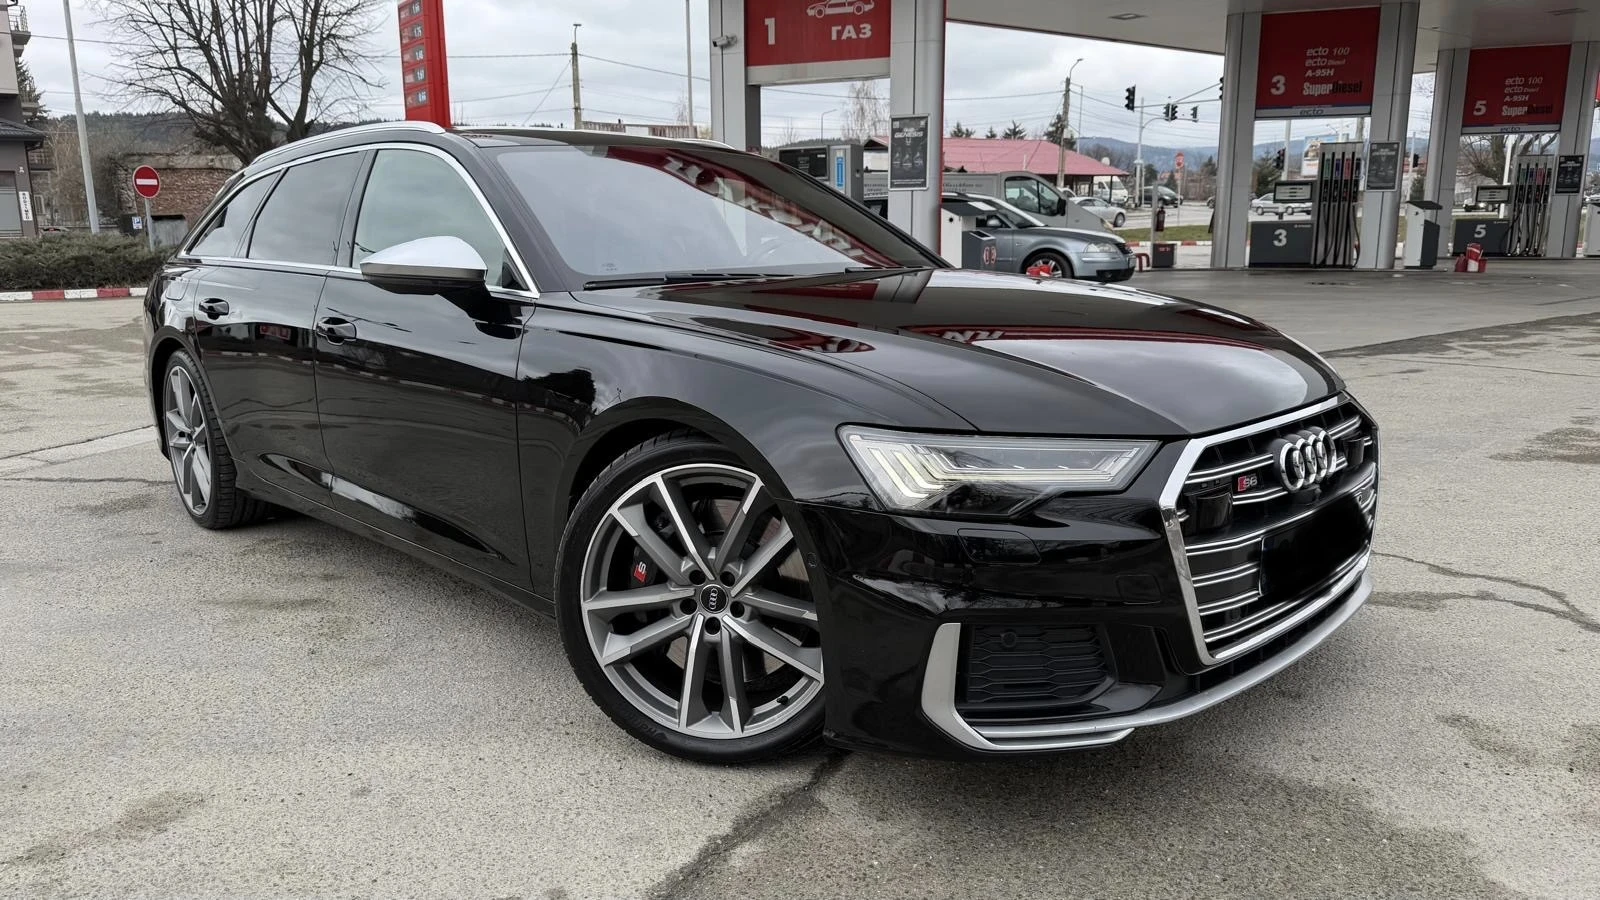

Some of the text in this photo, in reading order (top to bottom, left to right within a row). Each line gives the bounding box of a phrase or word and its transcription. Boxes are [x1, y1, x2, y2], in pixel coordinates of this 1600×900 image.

[764, 17, 776, 45] 1
[831, 23, 872, 41] ГАЗ
[1306, 46, 1350, 57] ecto 100
[1305, 57, 1327, 66] ecto
[1305, 69, 1334, 77] A-95H
[1505, 76, 1524, 85] ecto
[1270, 75, 1287, 95] 3
[1303, 81, 1362, 96] SuperDiesel
[1299, 108, 1324, 116] ecto
[1473, 100, 1487, 116] 5
[1272, 228, 1288, 247] 3
[1473, 224, 1487, 238] 5
[1241, 474, 1258, 489] S6
